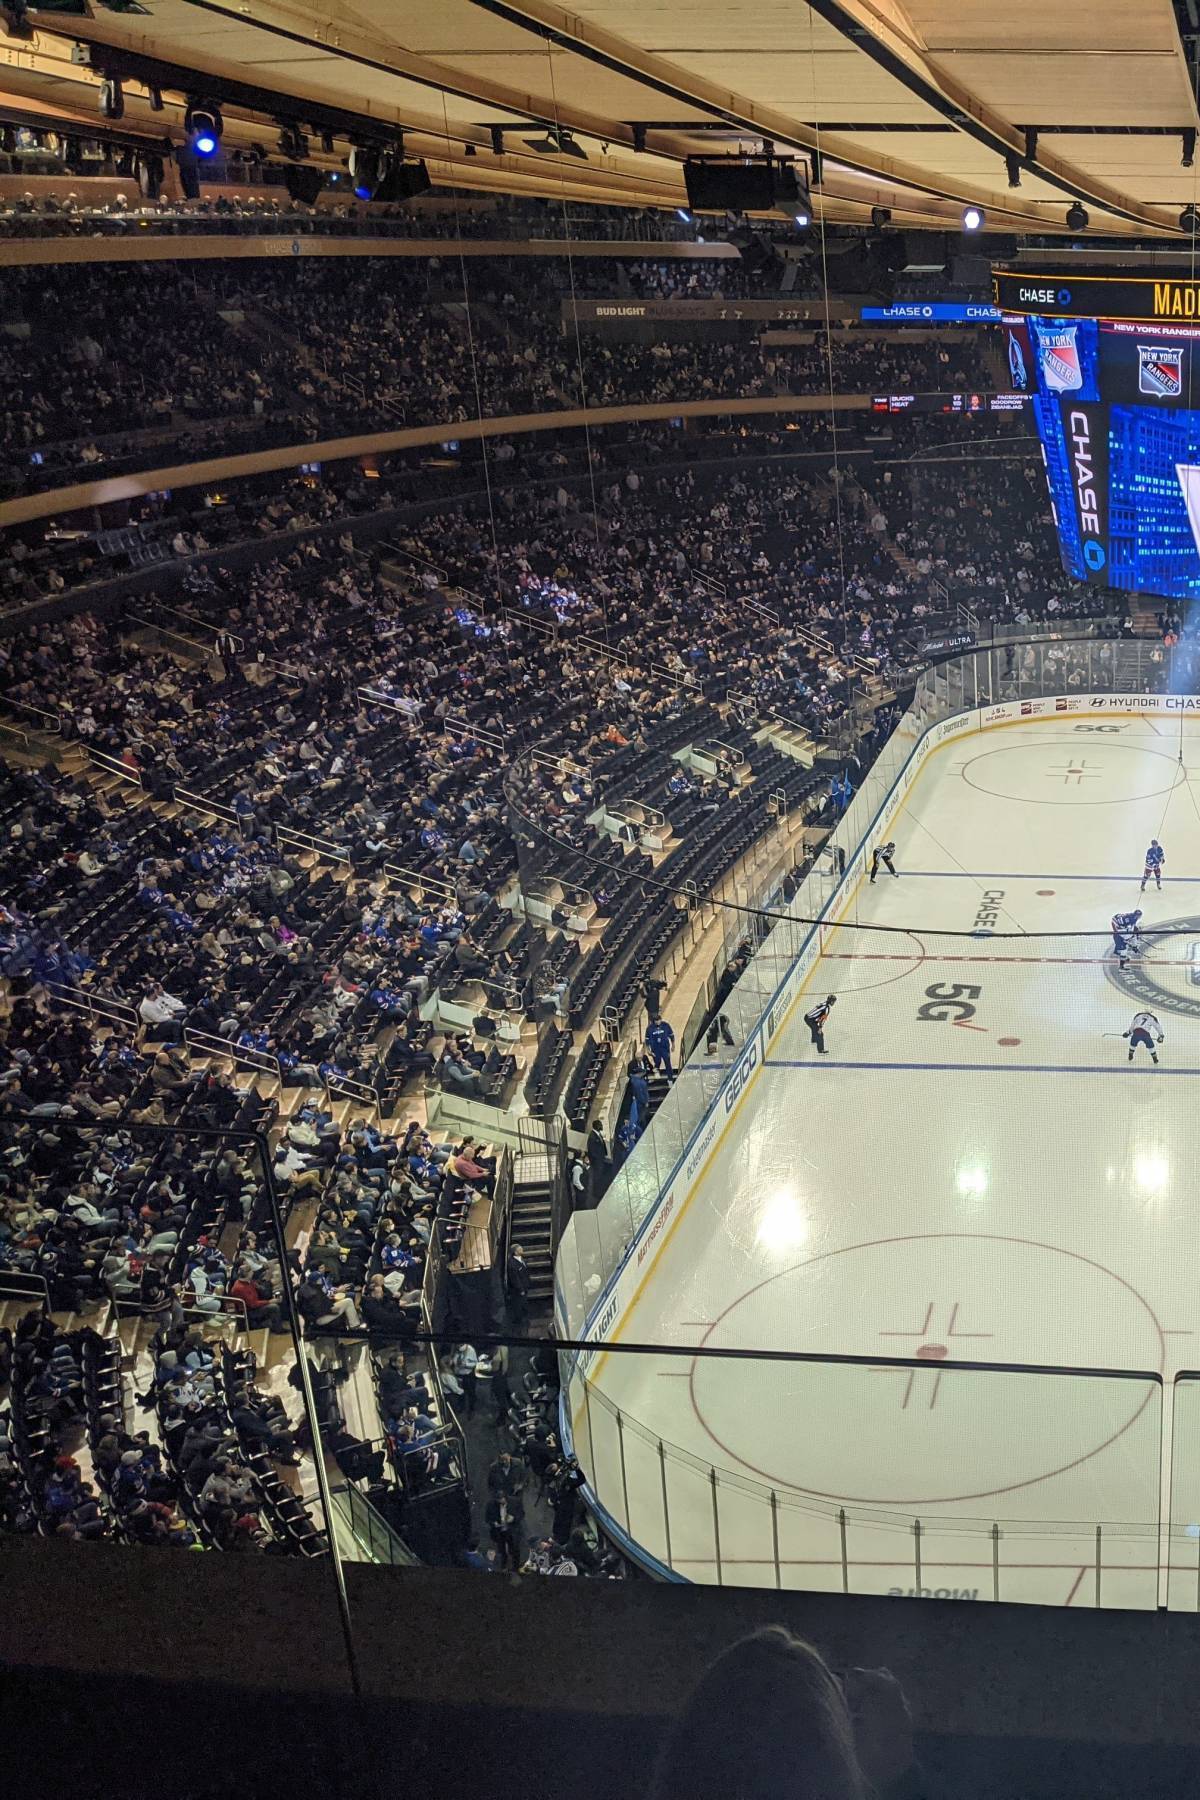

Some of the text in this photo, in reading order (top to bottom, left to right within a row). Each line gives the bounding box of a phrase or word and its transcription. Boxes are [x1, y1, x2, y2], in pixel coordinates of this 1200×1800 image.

[1019, 288, 1055, 303] CHASE
[596, 307, 617, 316] BUD
[618, 307, 645, 316] LIGHT
[883, 307, 921, 316] CHASE
[1113, 323, 1135, 332] NEW
[1136, 326, 1161, 334] YORK
[1141, 351, 1179, 361] NEW YORK
[1146, 362, 1178, 392] RANGERS
[1070, 411, 1100, 534] CHASE
[950, 635, 971, 647] ULTRA
[1109, 698, 1159, 707] HYUNDAI
[1073, 724, 1121, 733] 5G
[973, 889, 1005, 928] CHASE
[916, 981, 983, 1022] 5G
[1141, 1017, 1148, 1026] 7
[725, 1043, 758, 1114] GEICO
